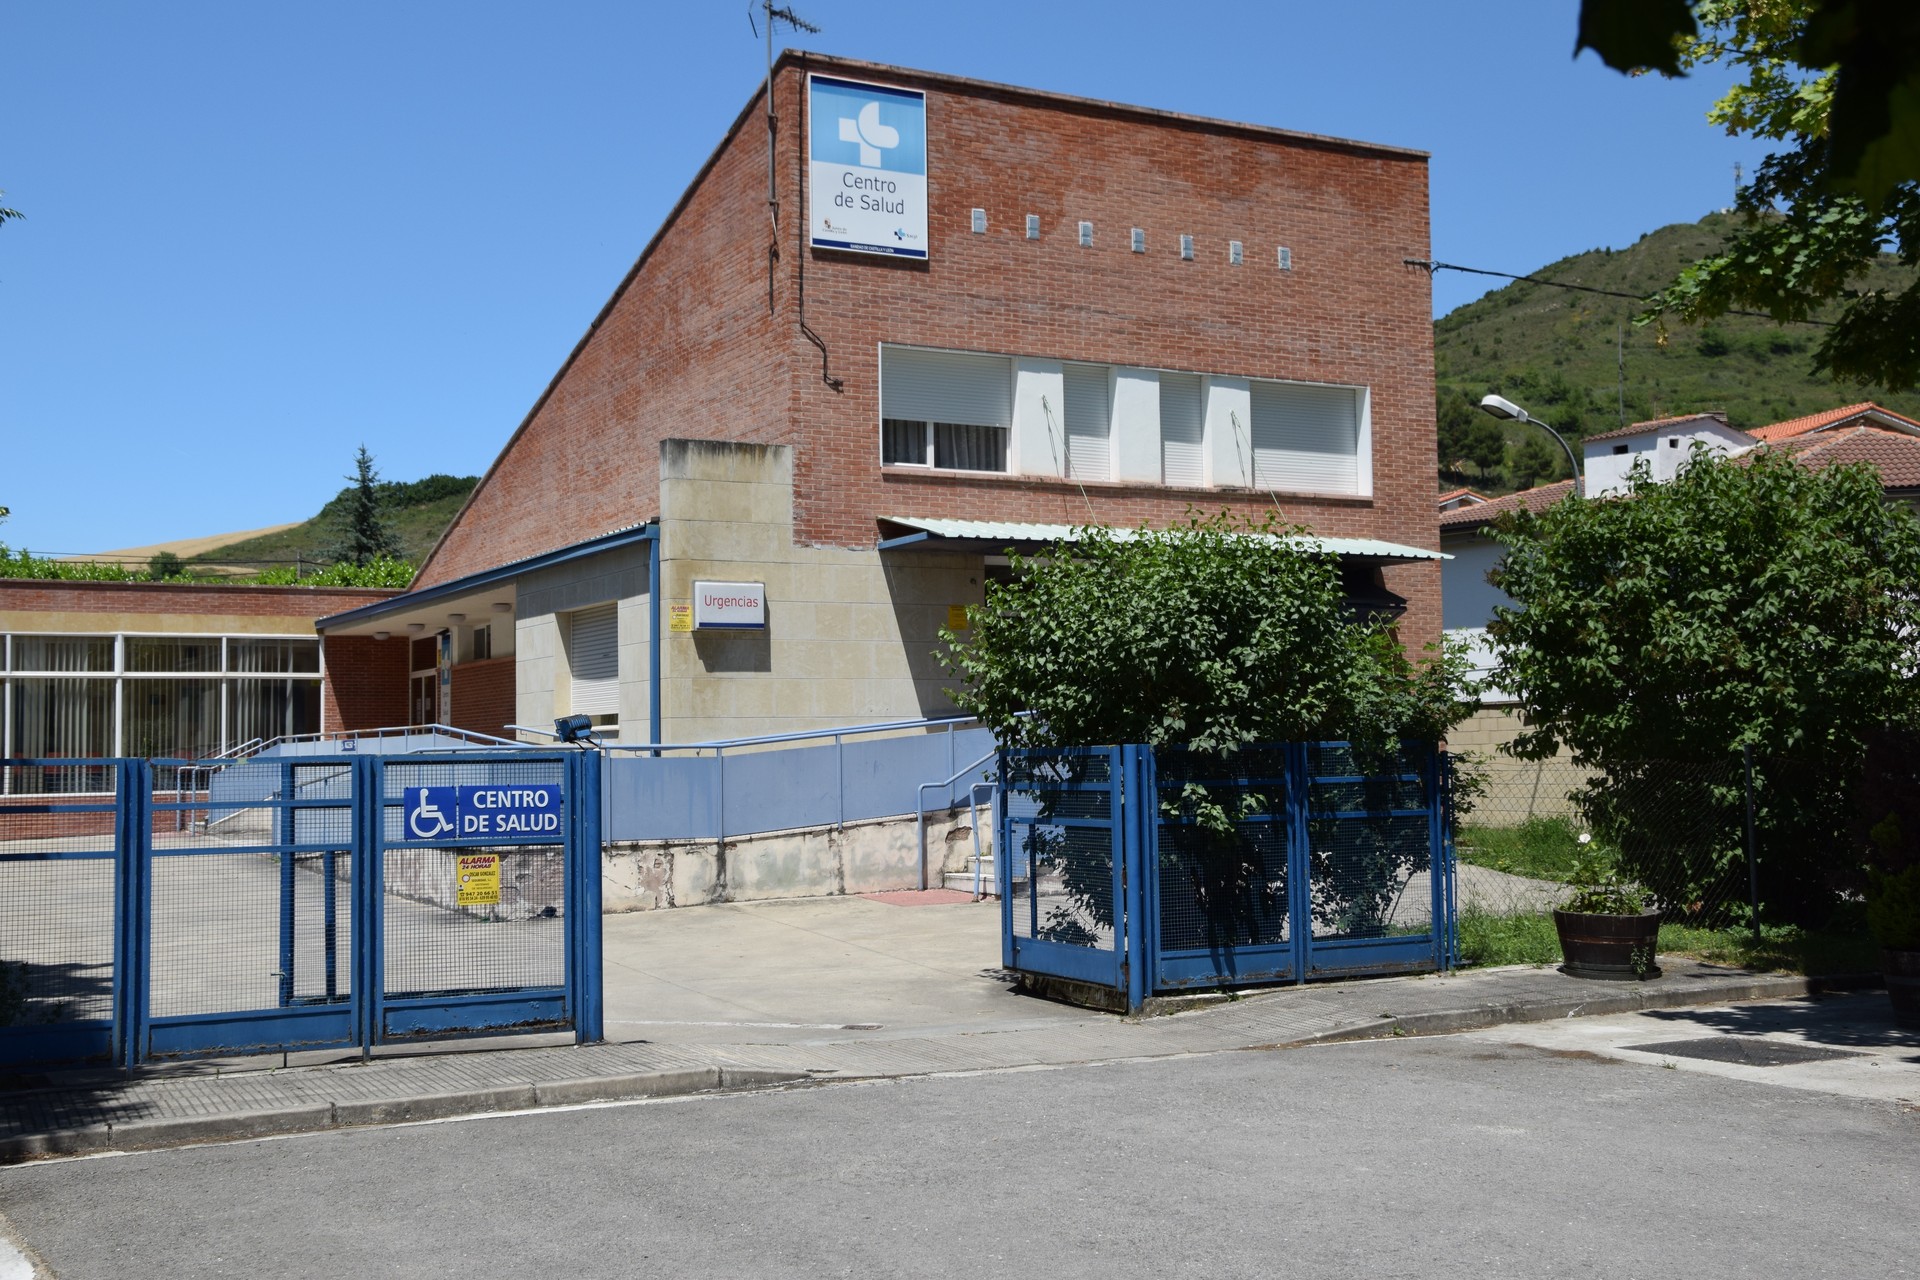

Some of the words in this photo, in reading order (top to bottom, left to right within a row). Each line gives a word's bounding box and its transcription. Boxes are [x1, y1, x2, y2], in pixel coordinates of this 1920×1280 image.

[843, 172, 897, 194] Centro
[834, 191, 854, 209] de
[860, 194, 905, 215] Salud
[704, 595, 759, 609] Urgencias
[473, 790, 549, 809] CENTRO
[464, 815, 489, 833] DE
[496, 813, 558, 832] SALUD
